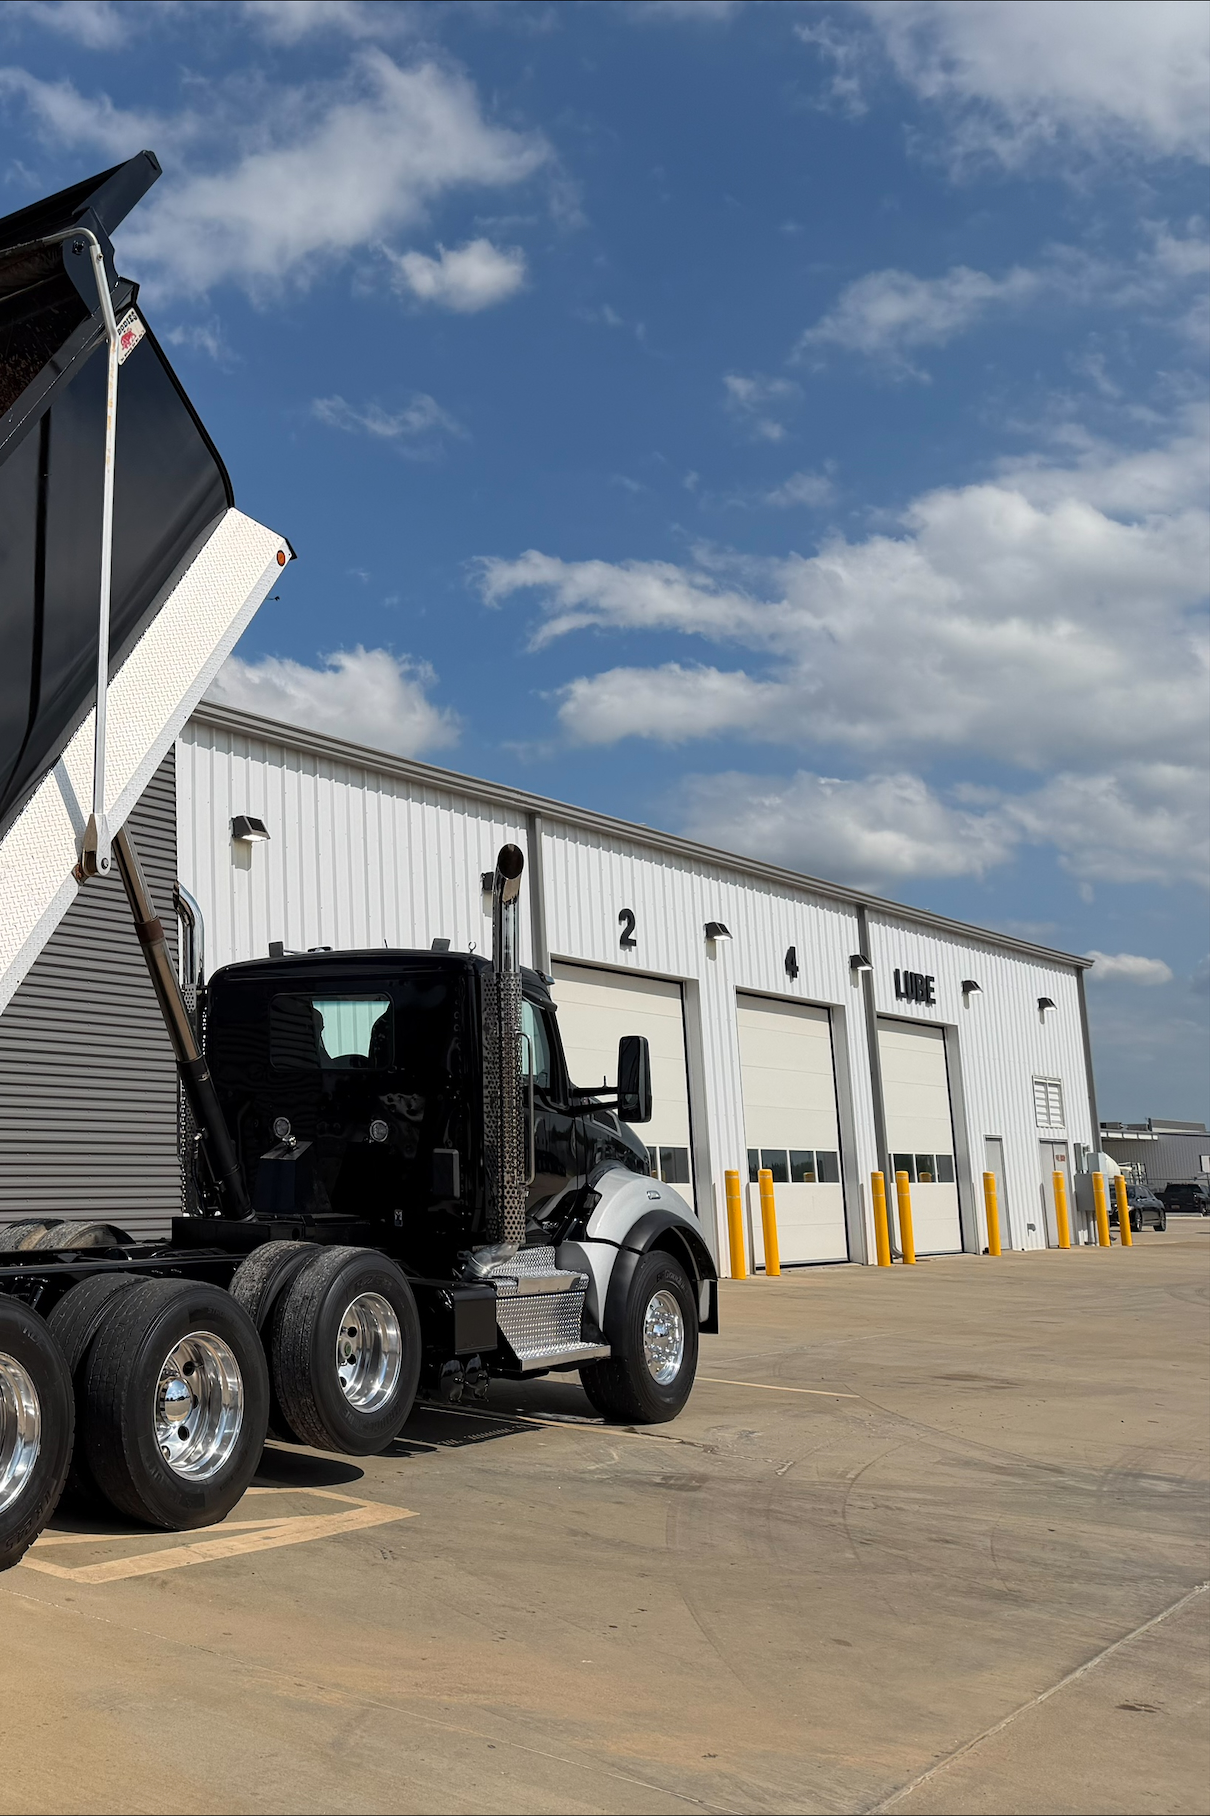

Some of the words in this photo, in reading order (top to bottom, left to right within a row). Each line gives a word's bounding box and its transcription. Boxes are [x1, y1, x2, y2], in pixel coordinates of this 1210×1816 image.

[618, 908, 637, 947] 2
[785, 946, 799, 979] 4
[894, 969, 936, 1005] LUBE
